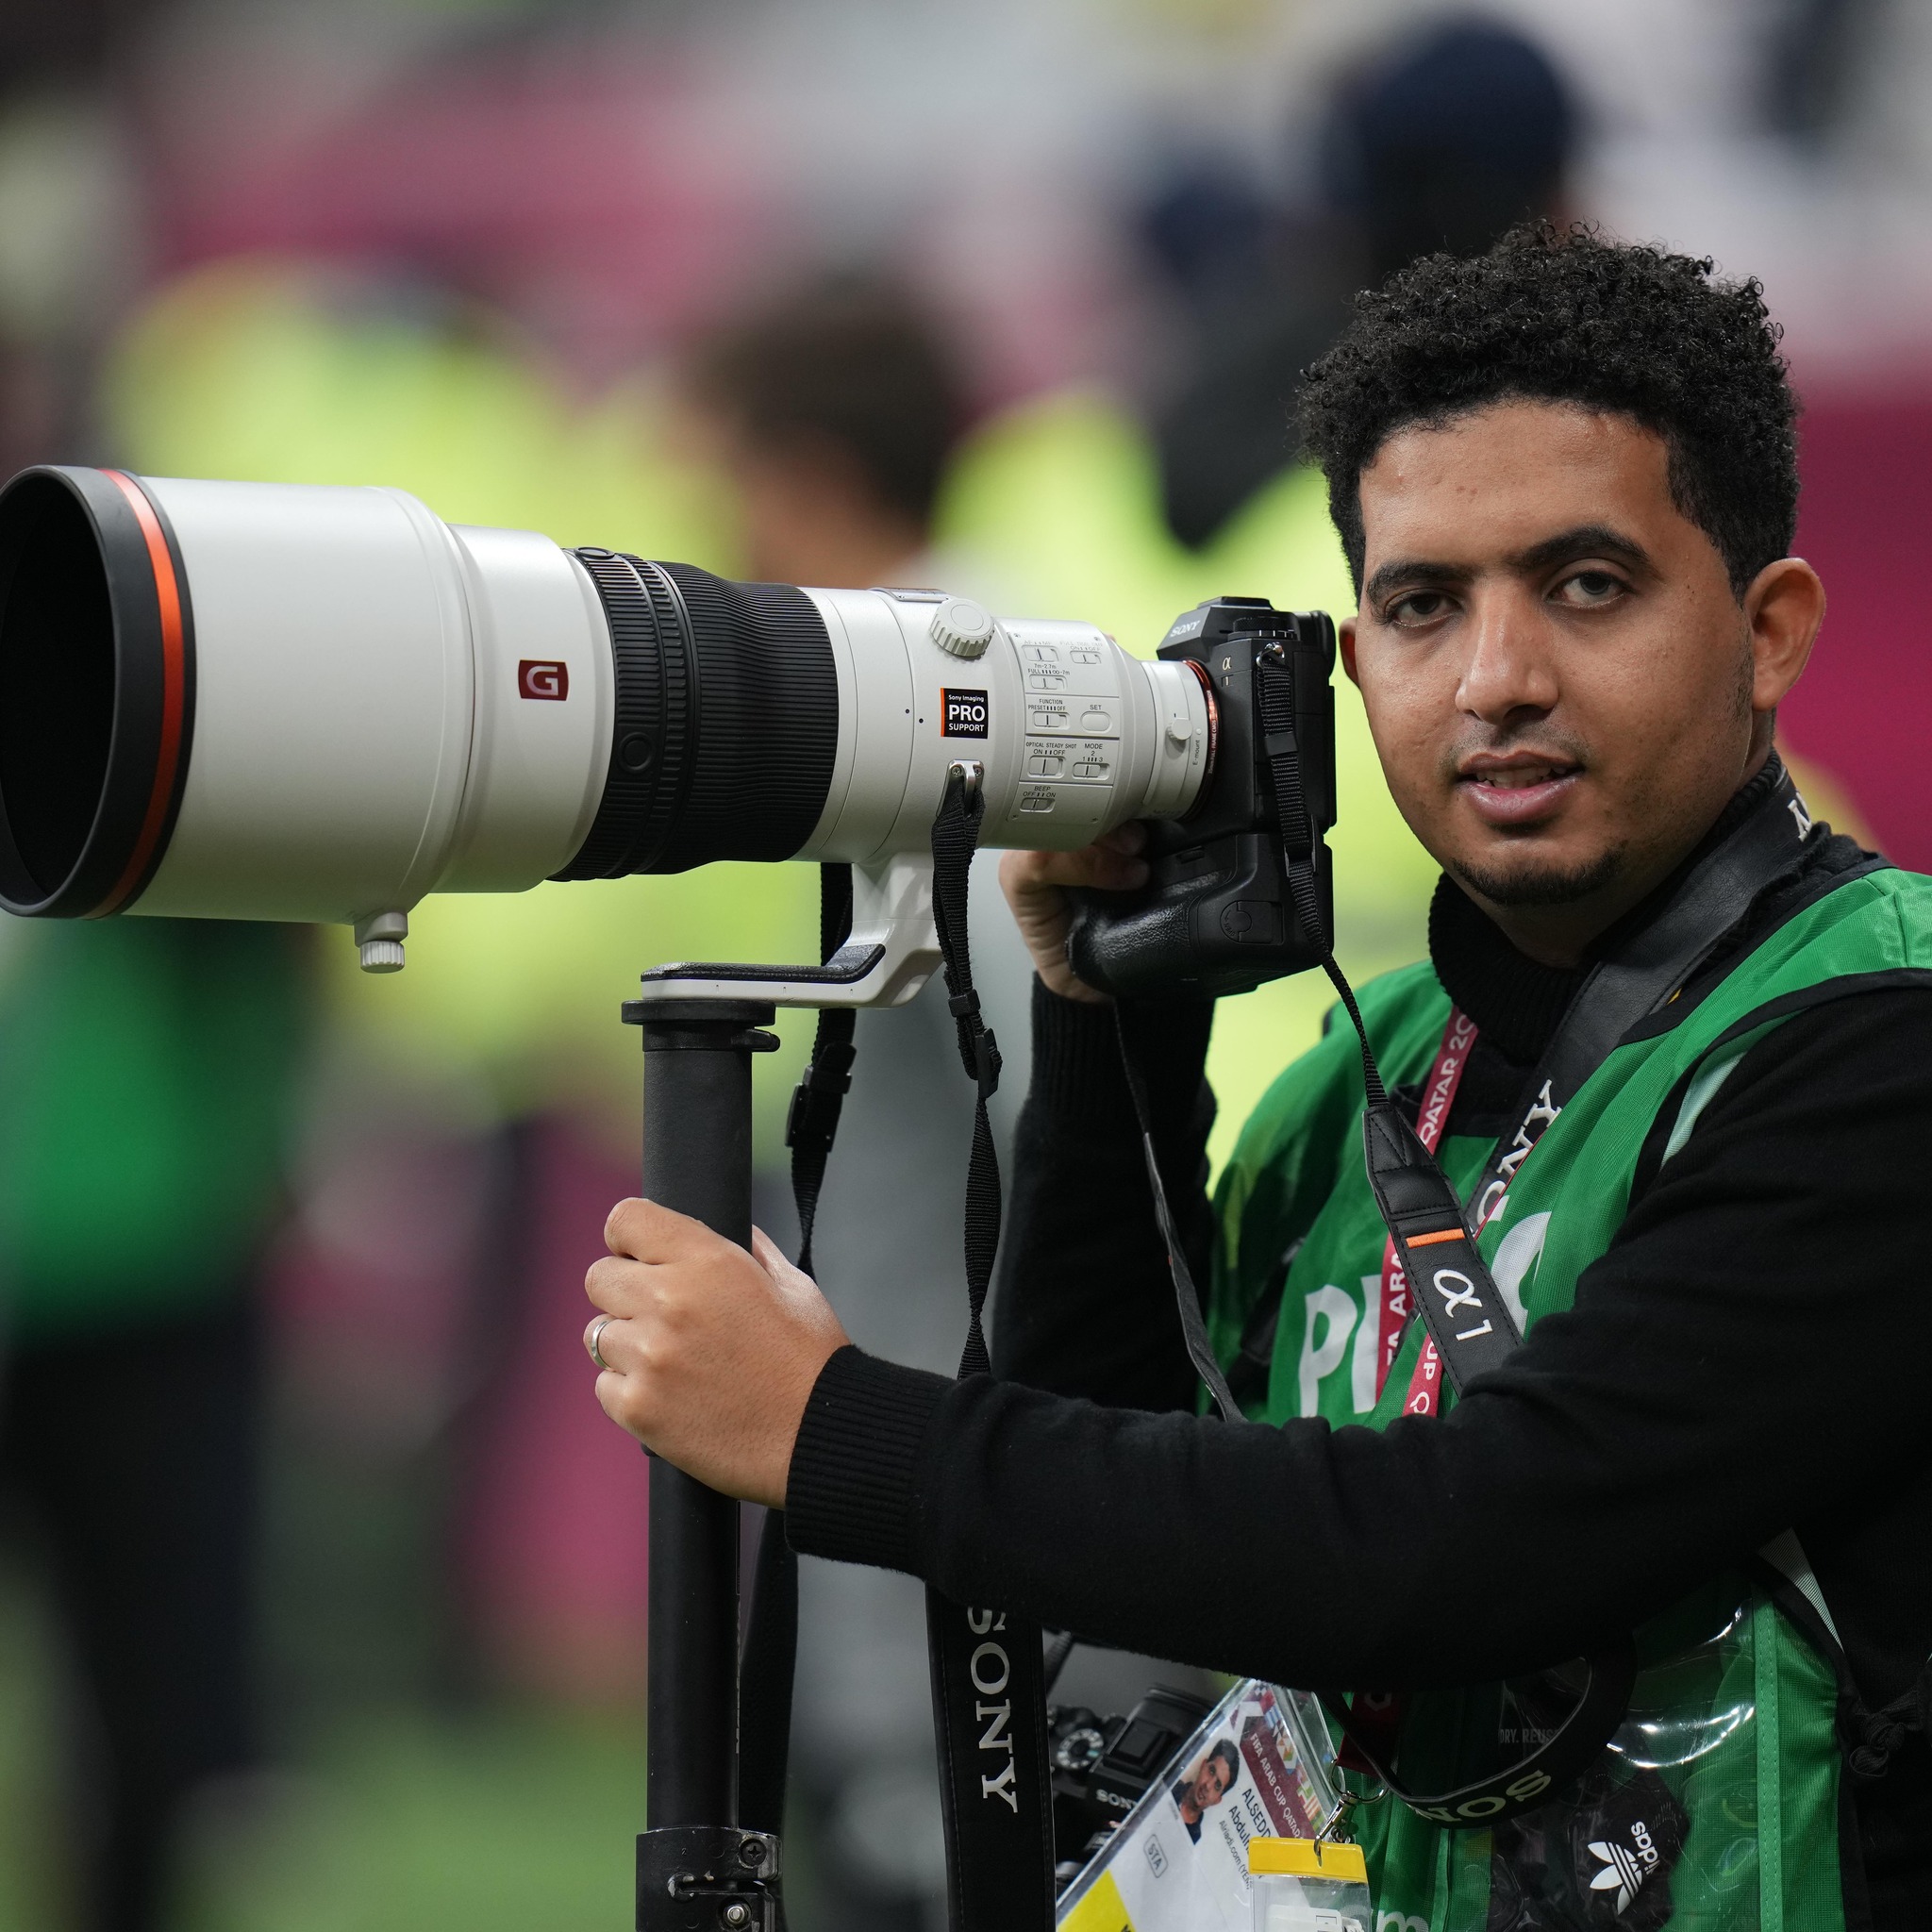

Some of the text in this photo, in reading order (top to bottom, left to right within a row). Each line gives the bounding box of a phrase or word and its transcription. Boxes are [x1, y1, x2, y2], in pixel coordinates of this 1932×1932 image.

[1170, 620, 1200, 638] SONY
[526, 665, 559, 696] G
[948, 704, 986, 722] PRO
[948, 723, 985, 732] SUPPORT
[1418, 1057, 1460, 1146] QATAR
[1250, 1732, 1264, 1757] FIFA
[1259, 1757, 1277, 1787] ARAB
[1274, 1786, 1287, 1807] CUP
[1148, 1842, 1162, 1870] STA
